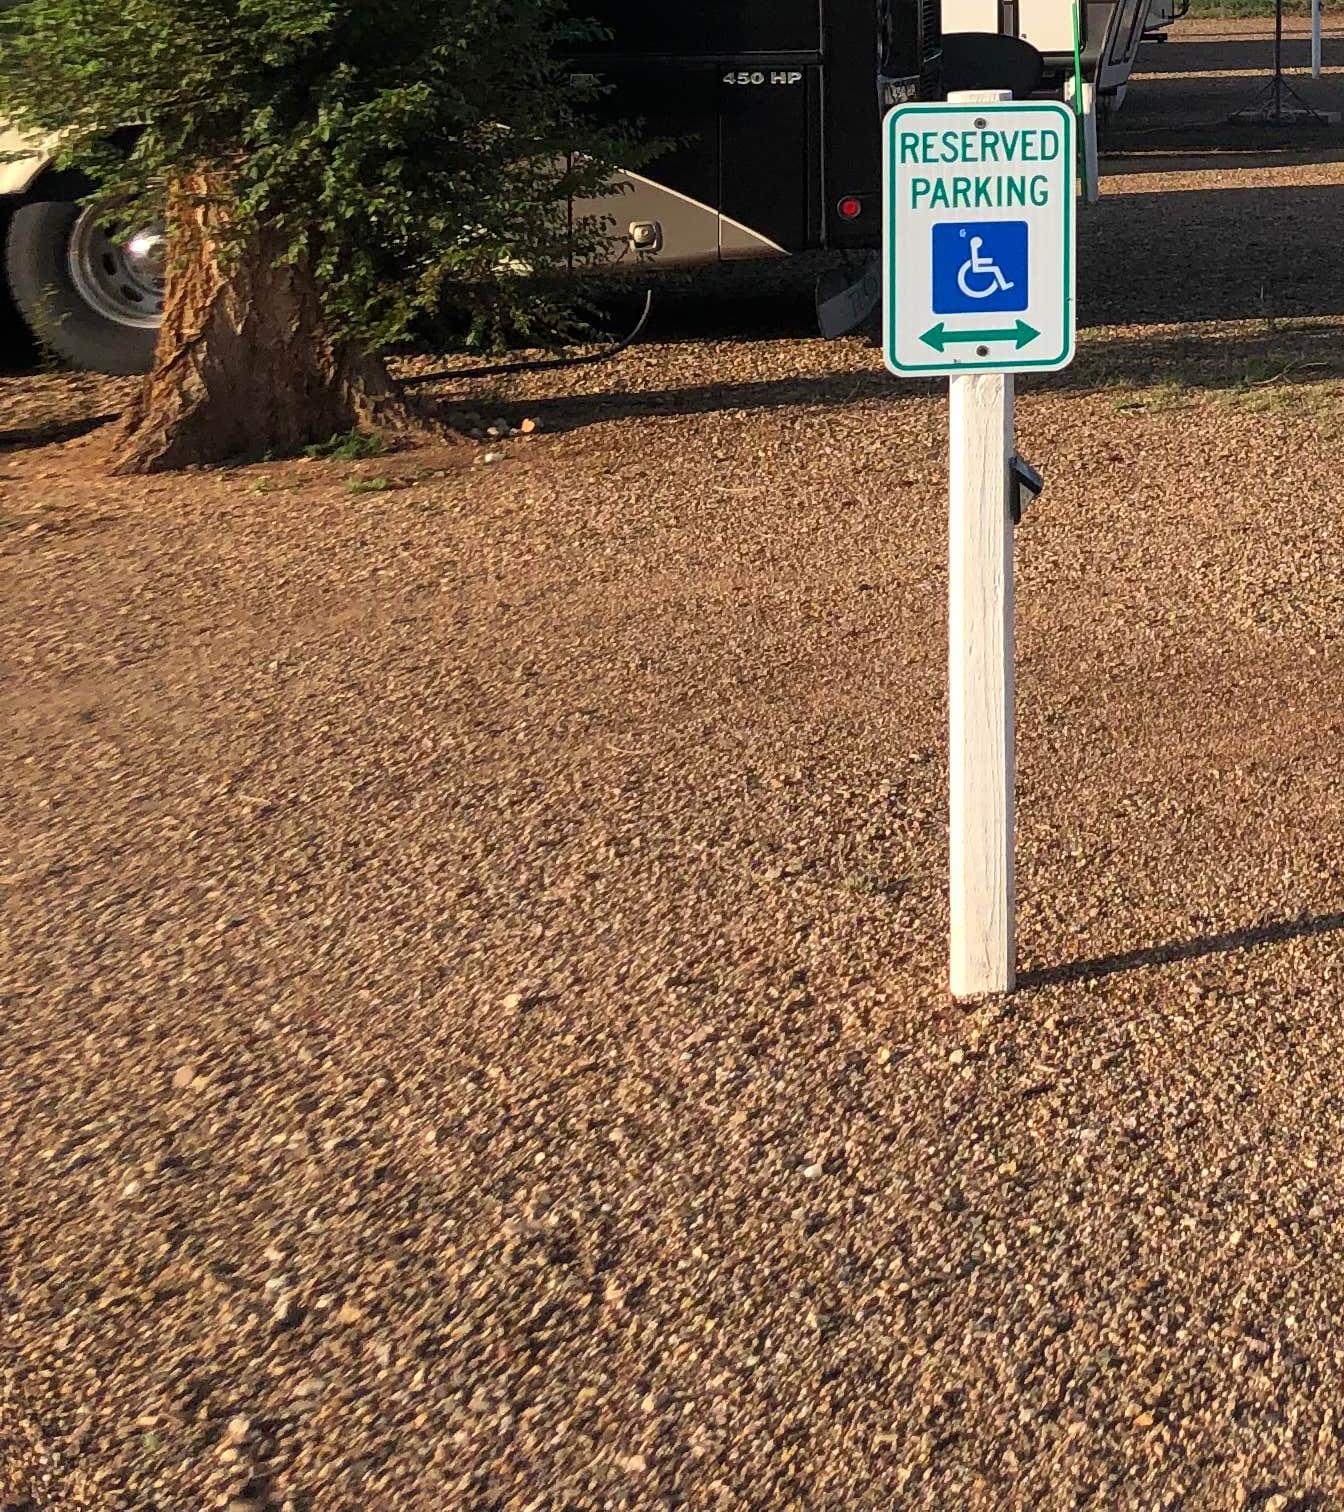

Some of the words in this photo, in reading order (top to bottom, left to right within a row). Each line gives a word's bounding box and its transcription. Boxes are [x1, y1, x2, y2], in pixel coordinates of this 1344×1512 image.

[722, 71, 764, 85] 450
[770, 71, 803, 85] HP
[900, 129, 1059, 164] RESERVED
[911, 174, 1049, 209] PARKING
